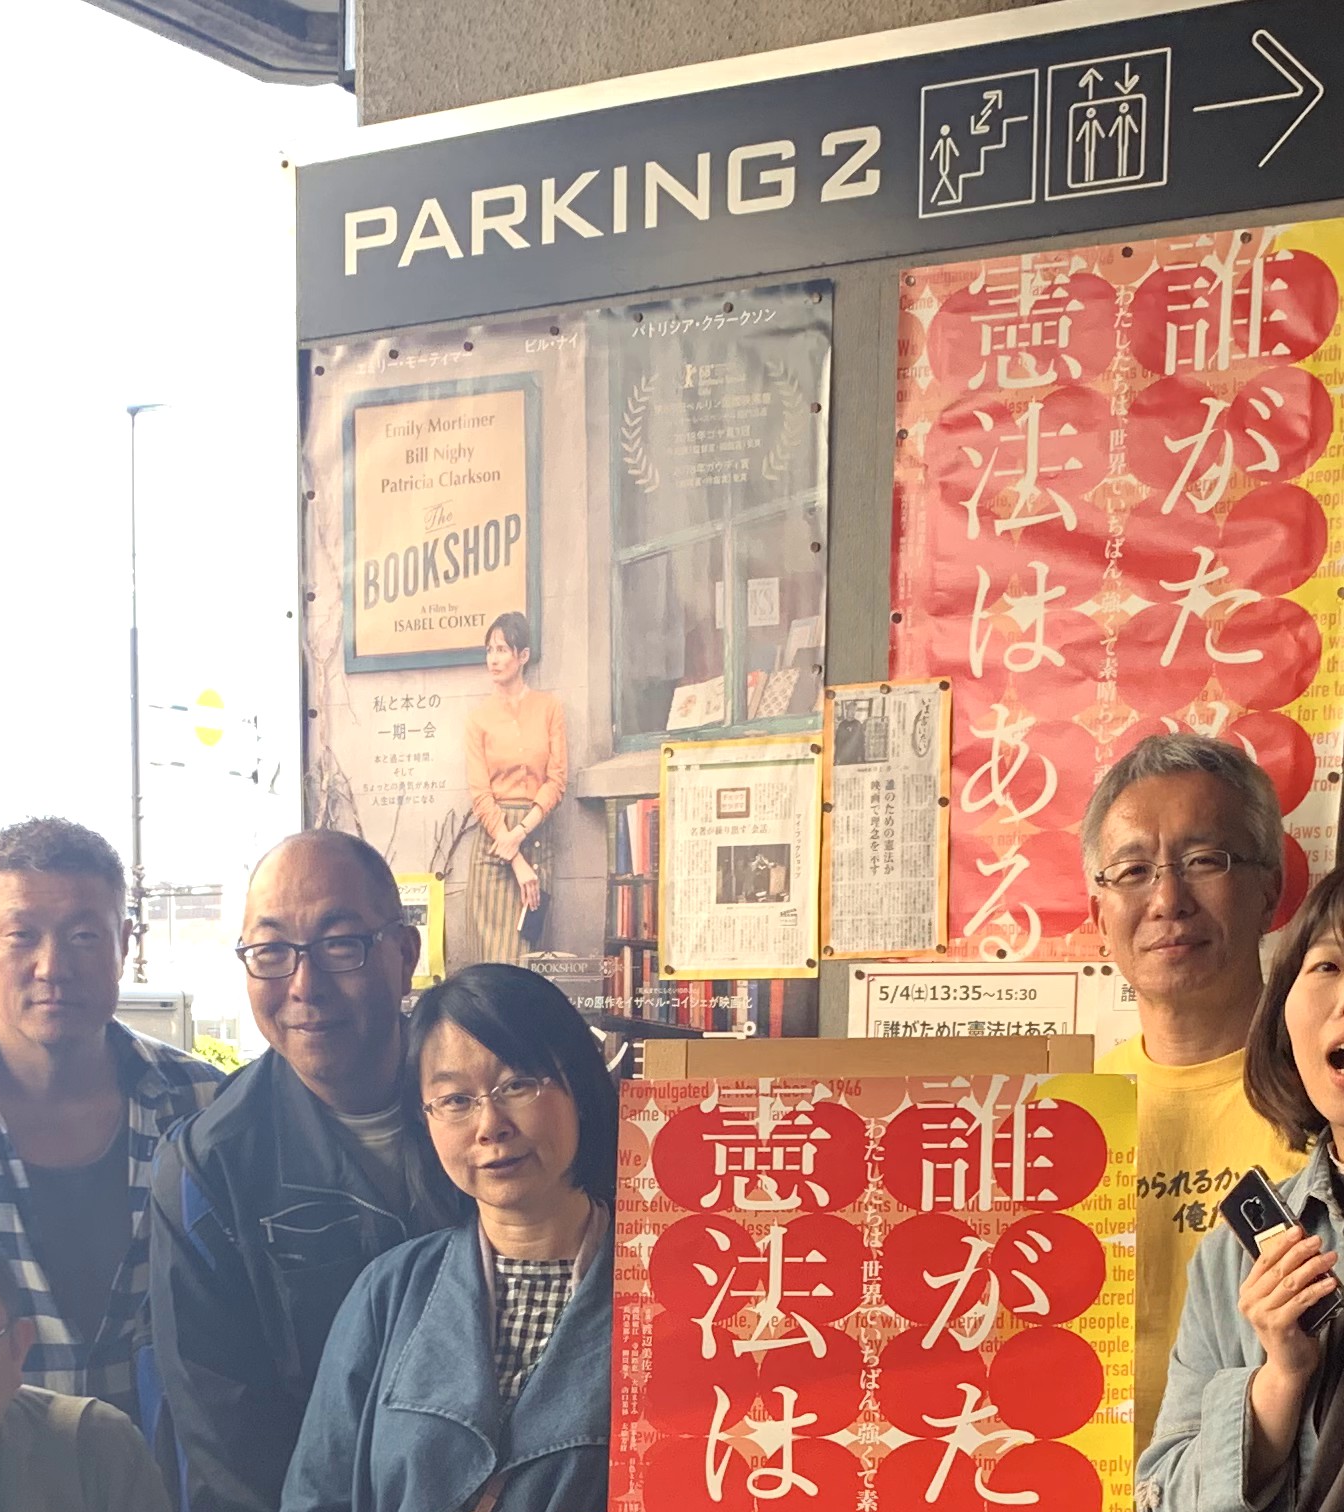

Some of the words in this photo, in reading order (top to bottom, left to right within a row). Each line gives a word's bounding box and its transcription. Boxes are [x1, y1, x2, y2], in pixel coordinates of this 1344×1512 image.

[343, 140, 797, 276] PARKING
[820, 125, 882, 204] 2
[632, 309, 777, 338] パトリシア・クラークソン
[524, 332, 578, 353] ビル・ナイ
[385, 422, 423, 441] Emily
[427, 414, 495, 433] Mortimer
[405, 448, 429, 465] Bill
[433, 445, 476, 466] Nighy
[381, 477, 435, 494] Patricia
[438, 469, 502, 488] Clarkson
[424, 504, 454, 530] The
[362, 513, 522, 611] BOOKSHOP
[429, 603, 446, 614] Film
[958, 254, 1087, 962] 憲法はある
[394, 616, 435, 633] ISABEL
[438, 613, 486, 630] COIXET
[373, 693, 442, 713] 私と本との
[1297, 705, 1319, 722] for
[1323, 704, 1344, 721] the
[377, 721, 437, 741] 一期一会
[393, 767, 415, 777] そして
[530, 962, 589, 974] BOOKSHOP
[620, 1080, 709, 1103] Promulgated
[829, 1079, 862, 1097] 1946
[620, 1105, 660, 1122] Came
[1081, 1193, 1112, 1210] with
[1117, 1193, 1136, 1210] all
[1112, 1240, 1135, 1258] the
[1112, 1265, 1135, 1282] the
[641, 1323, 654, 1383] 渡辺美佐子
[1110, 1483, 1132, 1496] we
